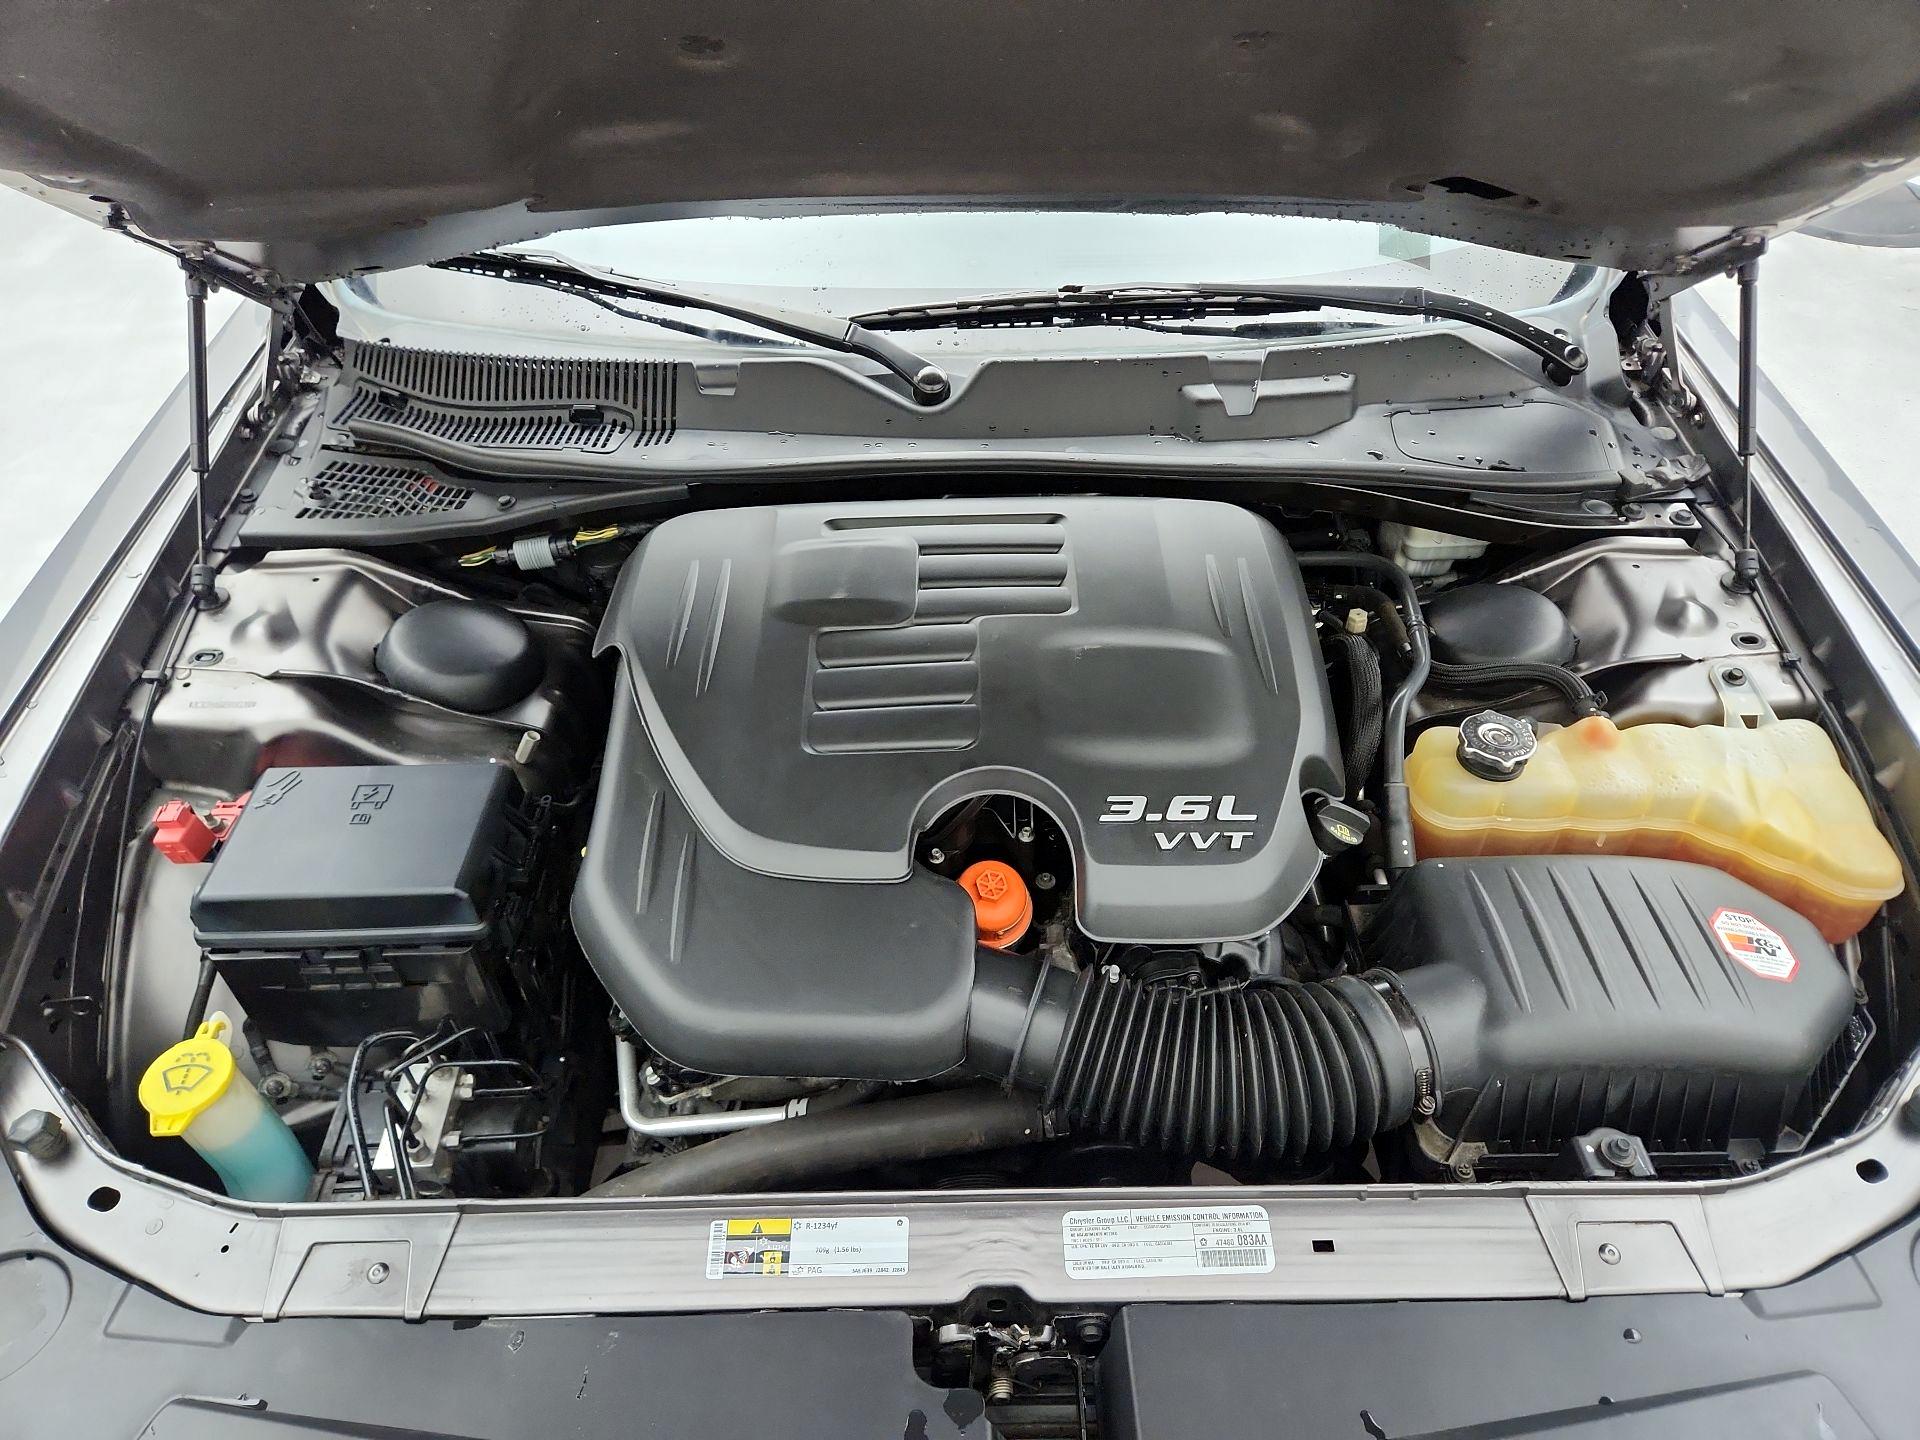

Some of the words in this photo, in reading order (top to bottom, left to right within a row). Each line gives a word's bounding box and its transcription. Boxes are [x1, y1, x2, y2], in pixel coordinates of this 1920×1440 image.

[1099, 795, 1258, 822] 3.6L
[1154, 832, 1254, 850] VVT
[1069, 1217, 1094, 1226] Chrysler
[1096, 1216, 1115, 1225] Group
[1116, 1215, 1129, 1224] LLC
[1135, 1214, 1160, 1223] VEHICLE
[1161, 1213, 1191, 1222] EMISSION
[1192, 1212, 1220, 1221] CONTROL
[1221, 1211, 1264, 1220] INFORMATION
[805, 1221, 838, 1230] R-1234yf
[1237, 1234, 1267, 1246] 083AA
[807, 1266, 823, 1274] PAG
